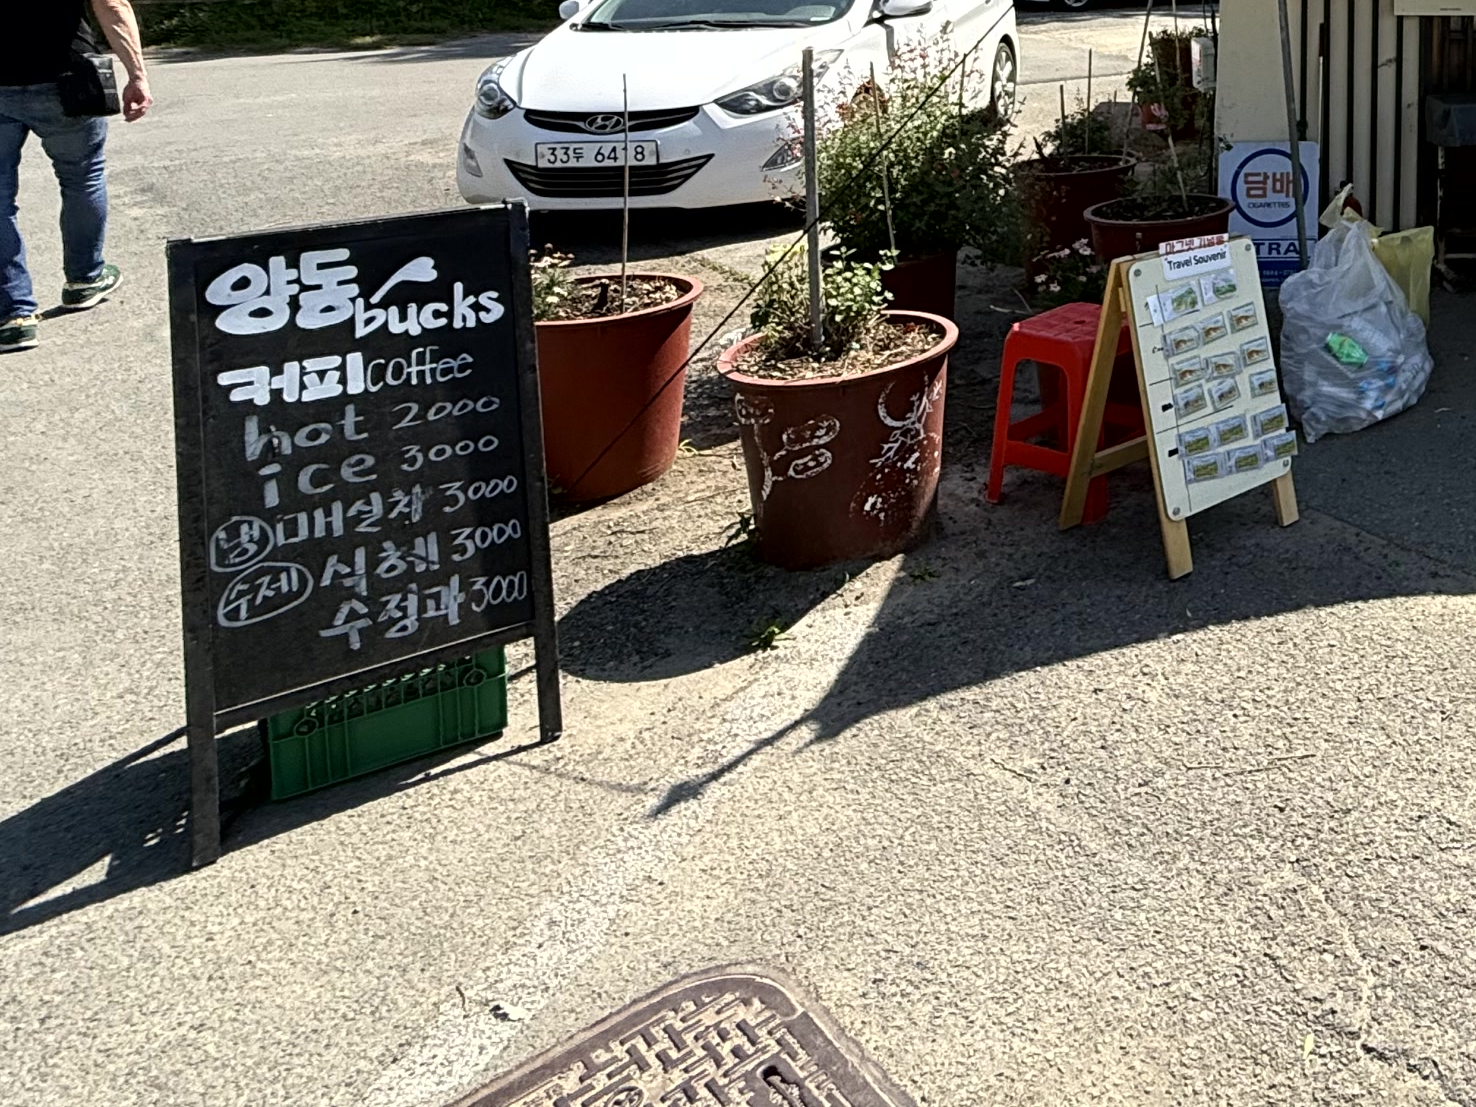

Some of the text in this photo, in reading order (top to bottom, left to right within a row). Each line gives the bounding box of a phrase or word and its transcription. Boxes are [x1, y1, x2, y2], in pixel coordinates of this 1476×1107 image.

[547, 146, 585, 165] 33두
[1243, 171, 1295, 199] 담배
[1247, 200, 1291, 209] CIGARETTES
[205, 247, 506, 339] 양동 bucks
[1166, 249, 1227, 271] Travel Souvenir
[217, 345, 474, 406] 커피 coffee
[244, 395, 501, 462] hot 2000
[257, 434, 500, 509] ice 3000
[275, 482, 431, 548] 매실차
[438, 474, 519, 513] 3000
[222, 566, 300, 622] 수제
[450, 518, 522, 562] 3000
[318, 570, 528, 651] 수정과 3000
